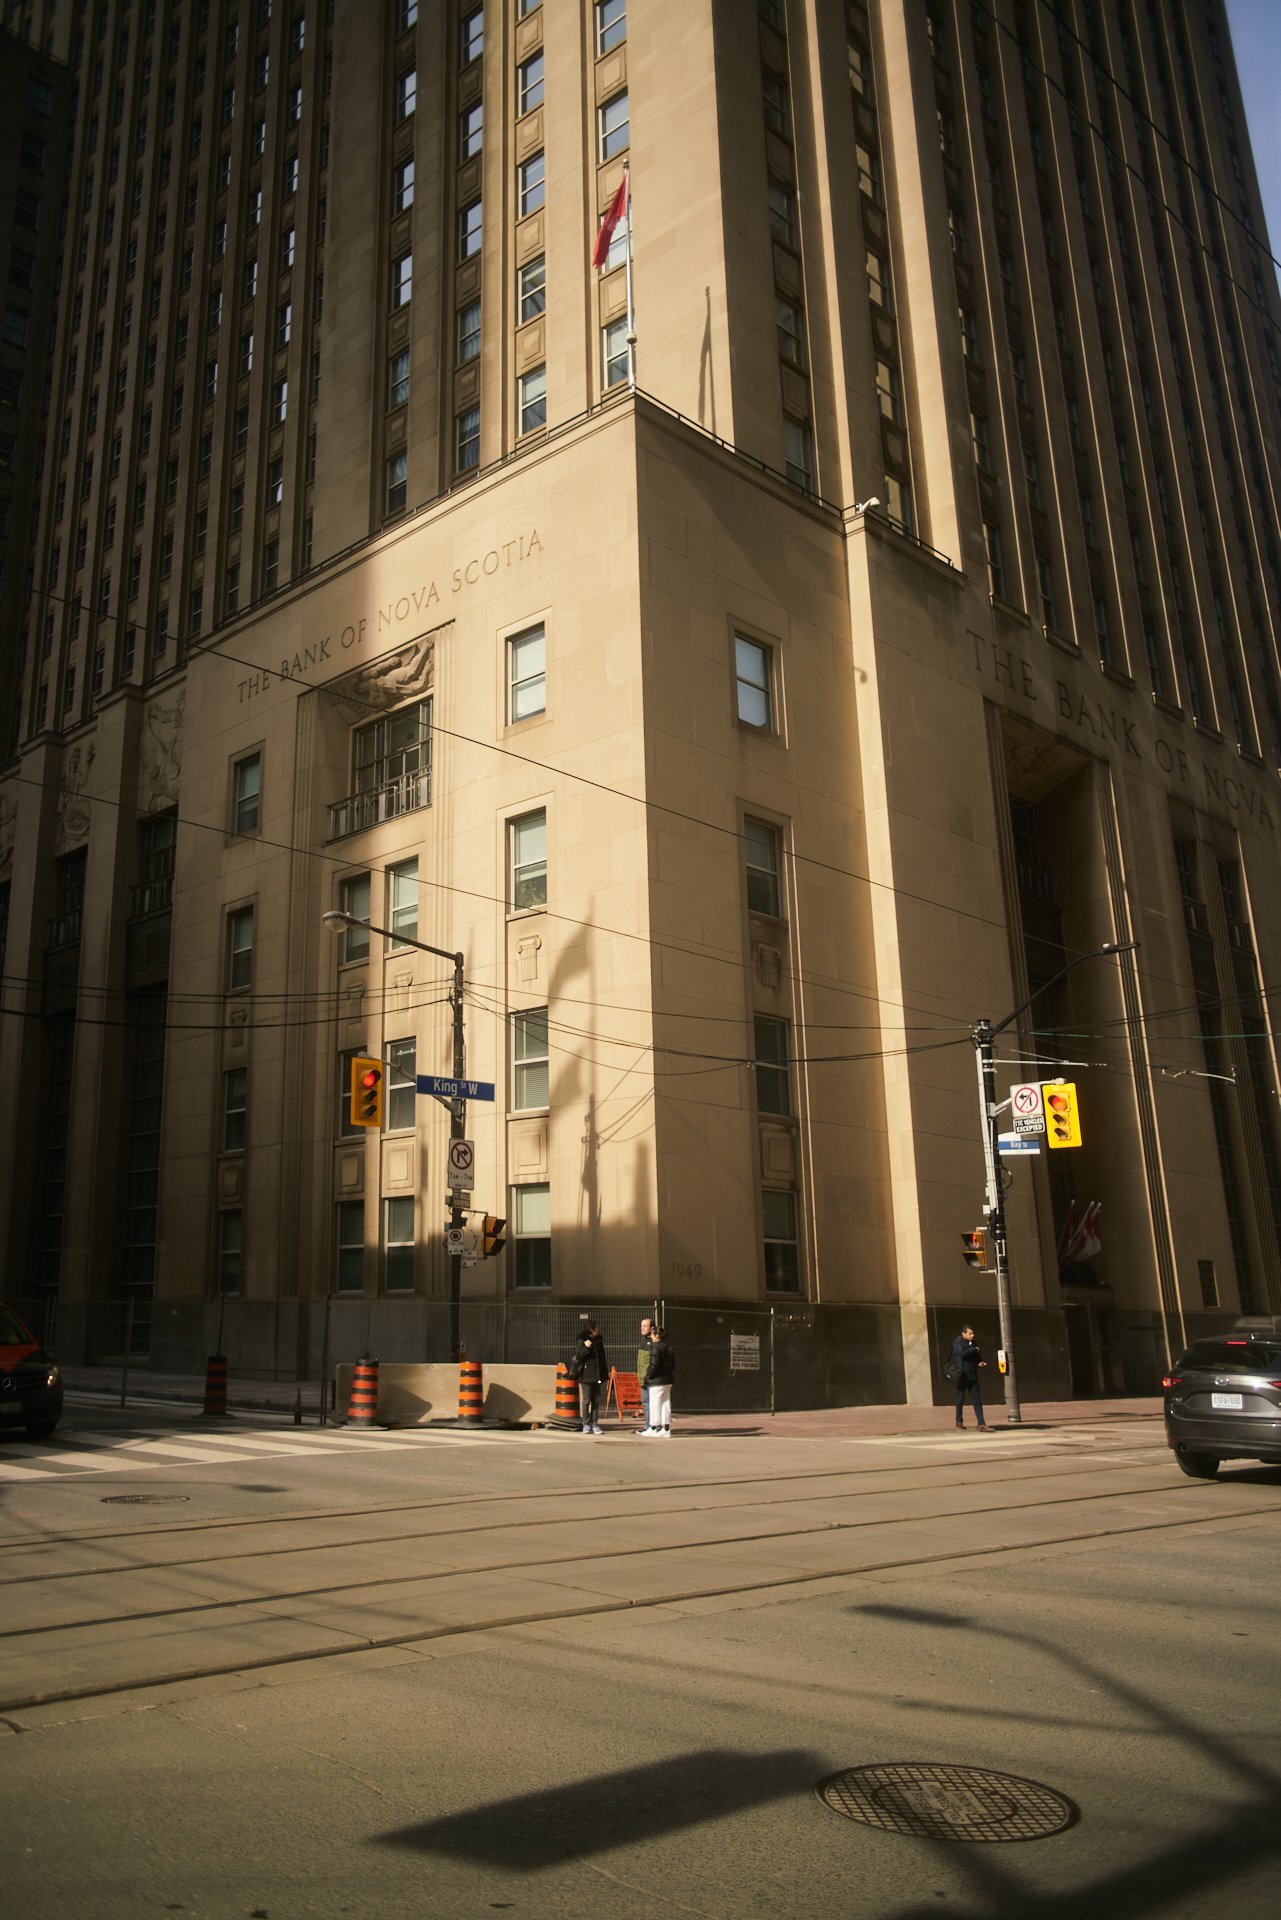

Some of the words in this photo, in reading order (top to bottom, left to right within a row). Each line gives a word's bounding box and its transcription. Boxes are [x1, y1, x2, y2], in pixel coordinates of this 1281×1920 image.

[236, 668, 271, 704] THE
[280, 636, 331, 682] BANK
[340, 618, 368, 649] OF
[377, 581, 441, 632] NOVA
[451, 529, 545, 594] SCOTIA
[966, 628, 1037, 701] THE
[1055, 680, 1142, 760] BANK
[1154, 738, 1187, 783] OF
[1202, 762, 1275, 831] NOVA
[433, 1079, 458, 1096] King
[468, 1082, 479, 1096] W
[1016, 1124, 1042, 1132] EXCEPTED
[1010, 1141, 1021, 1149] Bay
[672, 1261, 702, 1280] 1949
